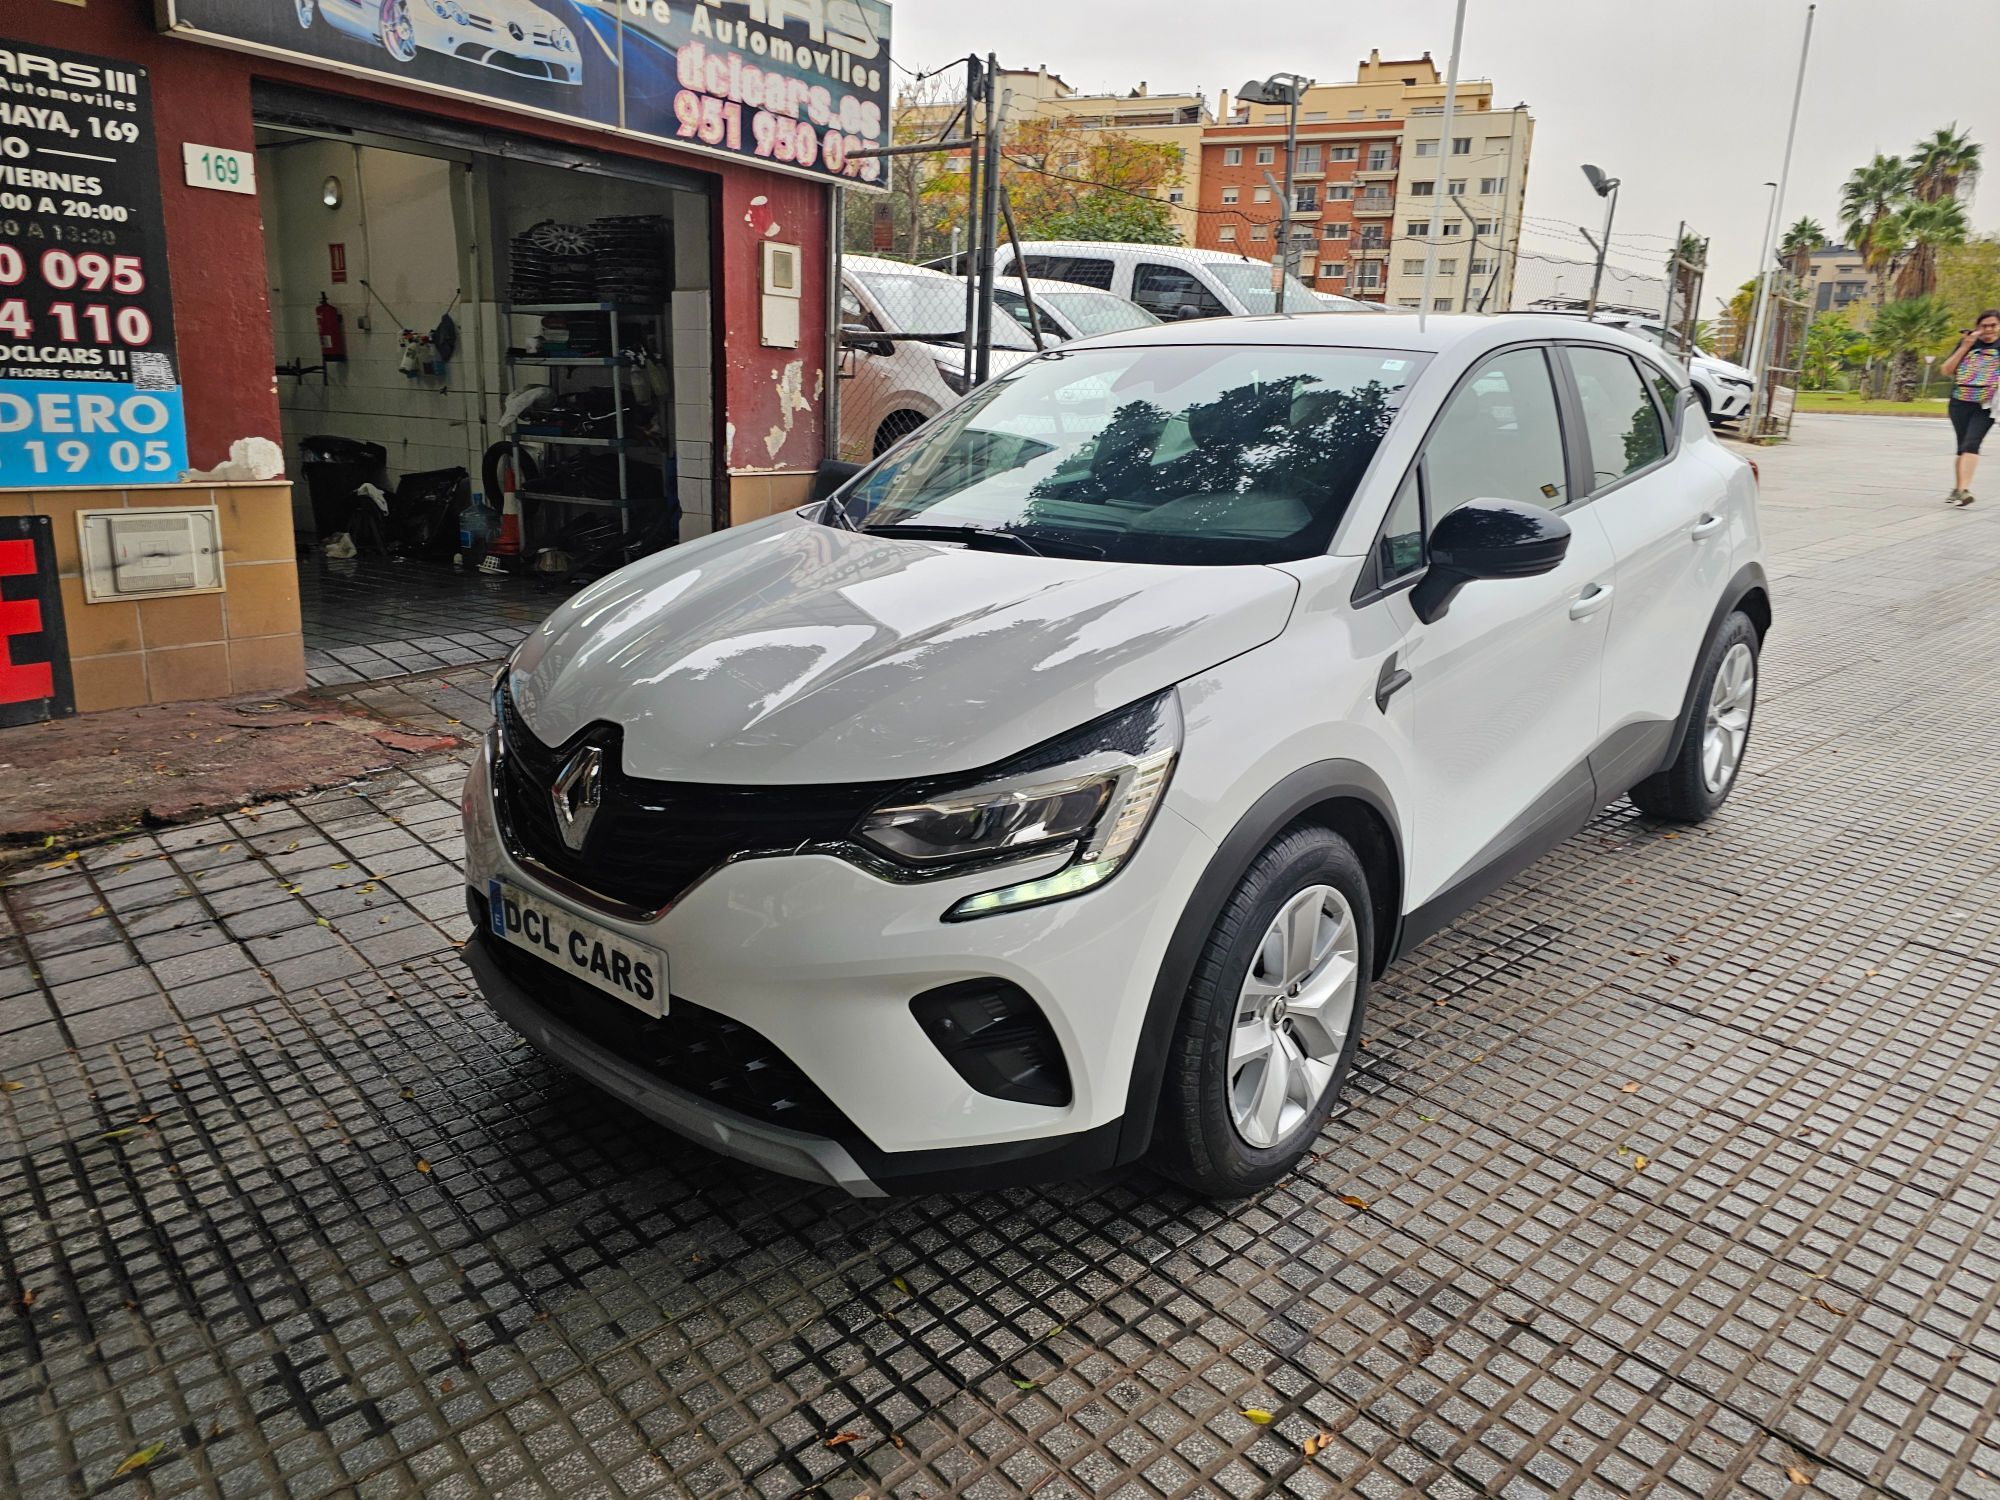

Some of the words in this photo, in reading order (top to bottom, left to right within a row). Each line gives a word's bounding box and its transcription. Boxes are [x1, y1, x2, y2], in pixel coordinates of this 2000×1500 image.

[627, 0, 671, 24] de
[691, 4, 881, 92] Automoviles
[105, 69, 138, 95] III
[88, 116, 140, 143] 169
[673, 89, 742, 150] 951
[752, 110, 817, 167] 950
[201, 152, 240, 185] 169
[37, 197, 58, 214] A
[61, 200, 128, 222] 20:00
[40, 248, 145, 295] 095
[0, 298, 34, 340] 4
[49, 301, 152, 346] 110
[9, 367, 60, 379] FLORES
[0, 393, 170, 434] DERO
[24, 440, 91, 474] 19
[109, 440, 172, 473] 05
[503, 897, 560, 955] DCL
[568, 929, 655, 1001] CARS
